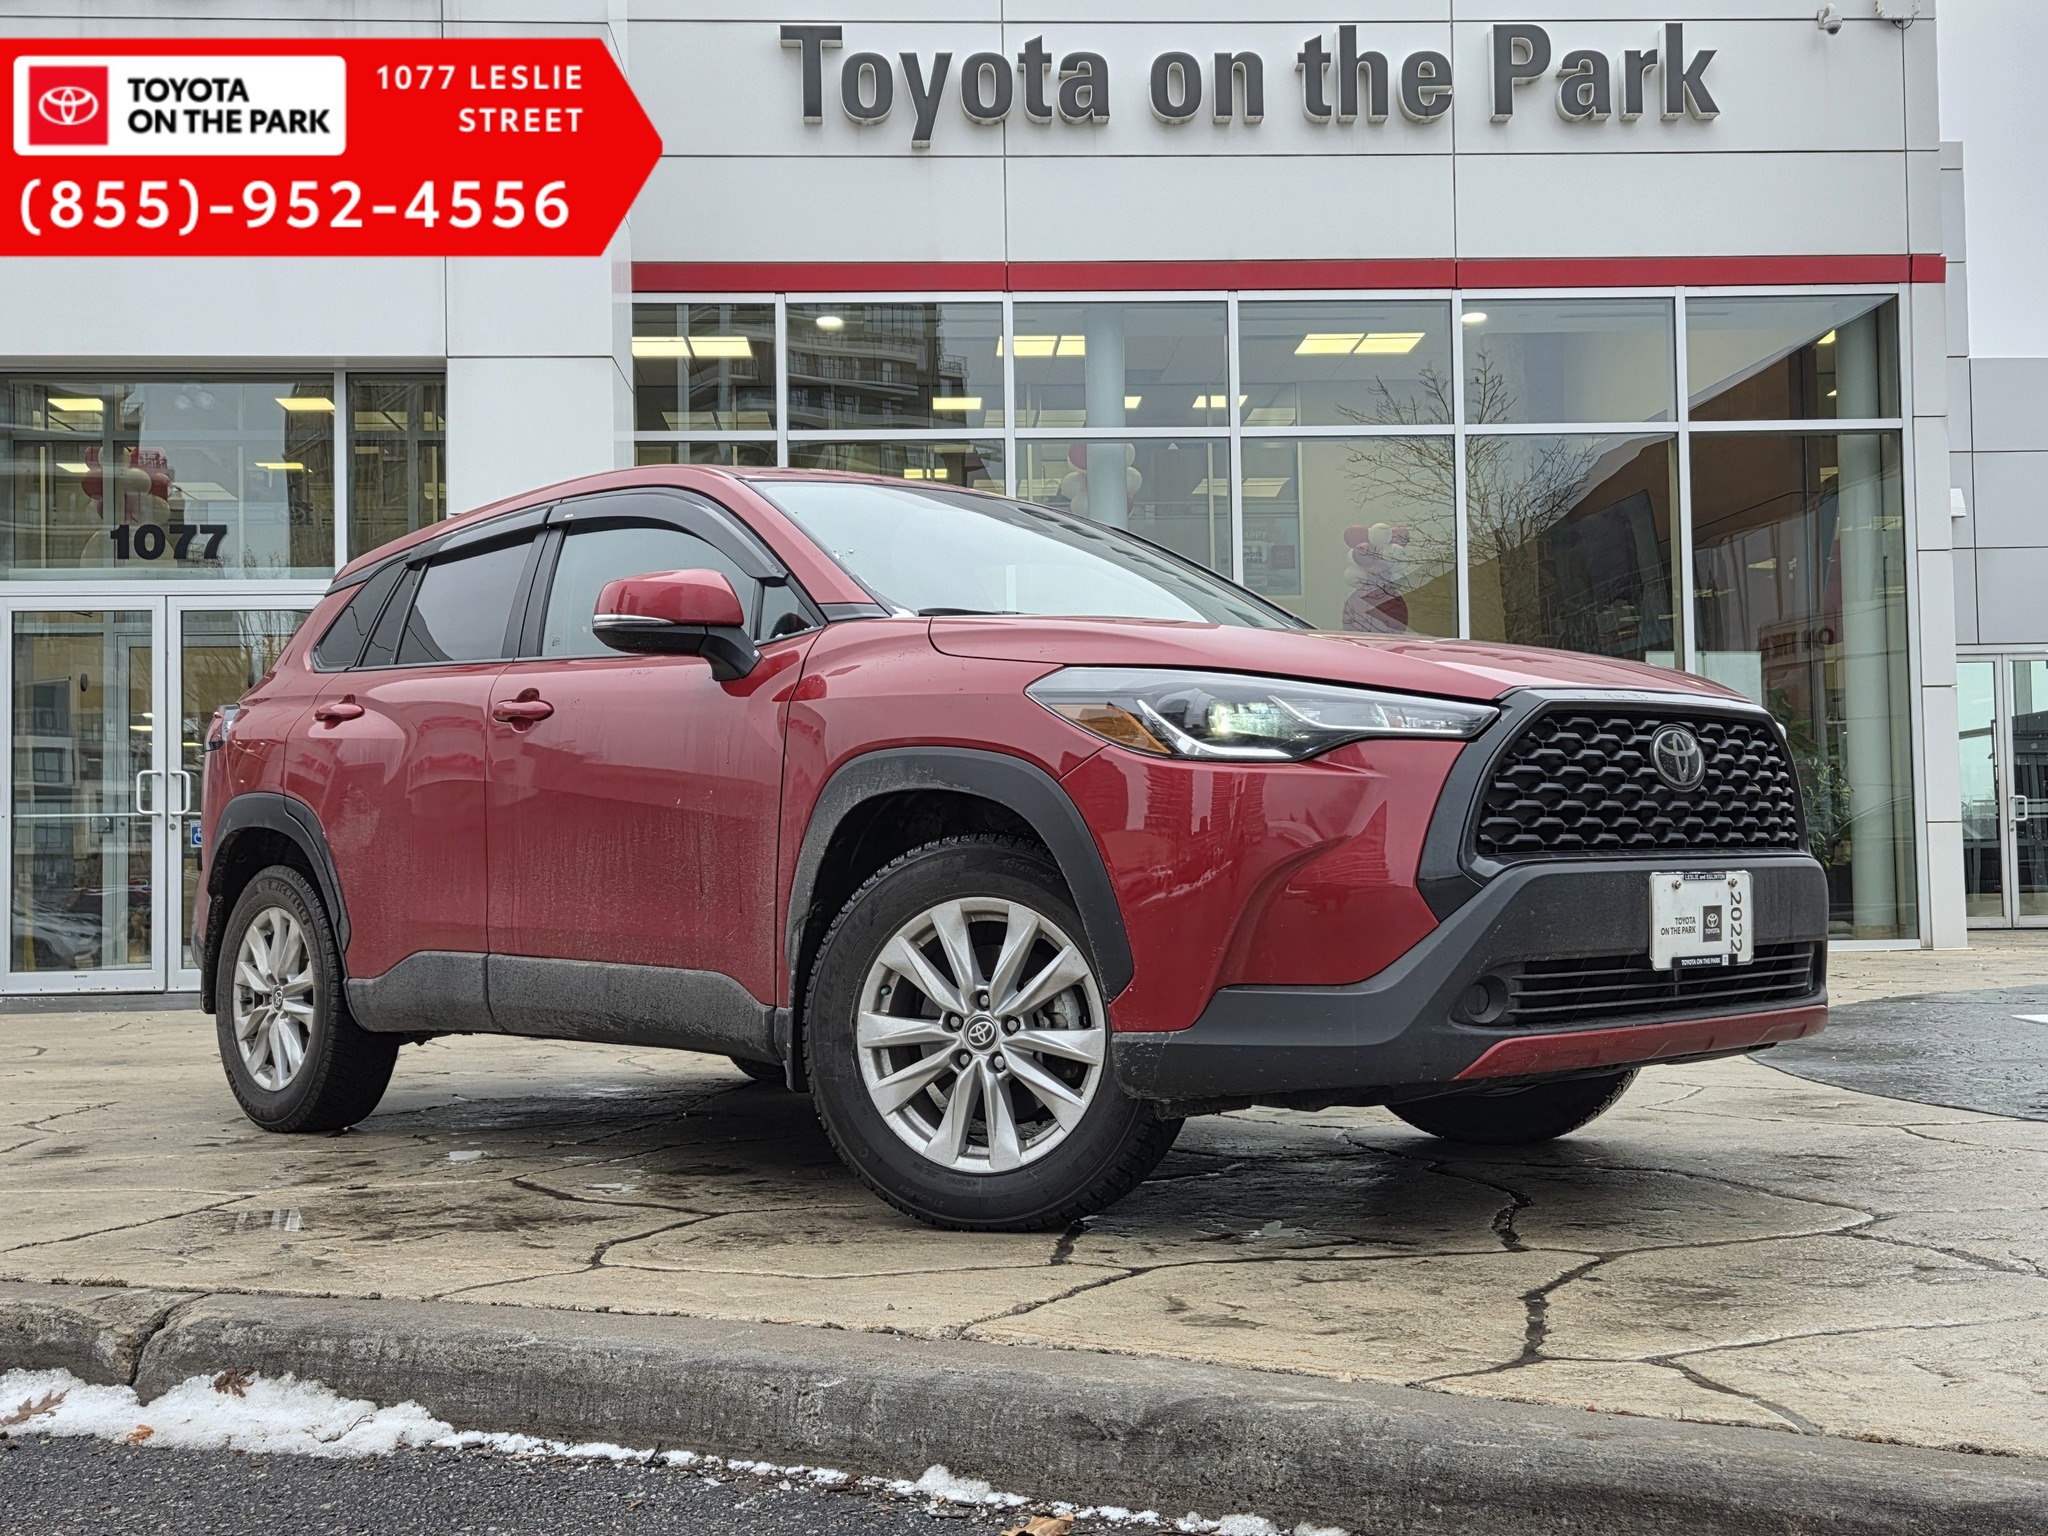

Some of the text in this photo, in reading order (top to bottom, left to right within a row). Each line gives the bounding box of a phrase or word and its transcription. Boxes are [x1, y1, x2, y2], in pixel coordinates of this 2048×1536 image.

[779, 23, 1720, 148] Toyota on the Park
[110, 524, 227, 560] 1077
[1660, 925, 1696, 935] ON THE PARK
[1675, 916, 1696, 925] TOYOTA
[1730, 891, 1743, 953] 2022
[1681, 958, 1696, 966] TOYOTA
